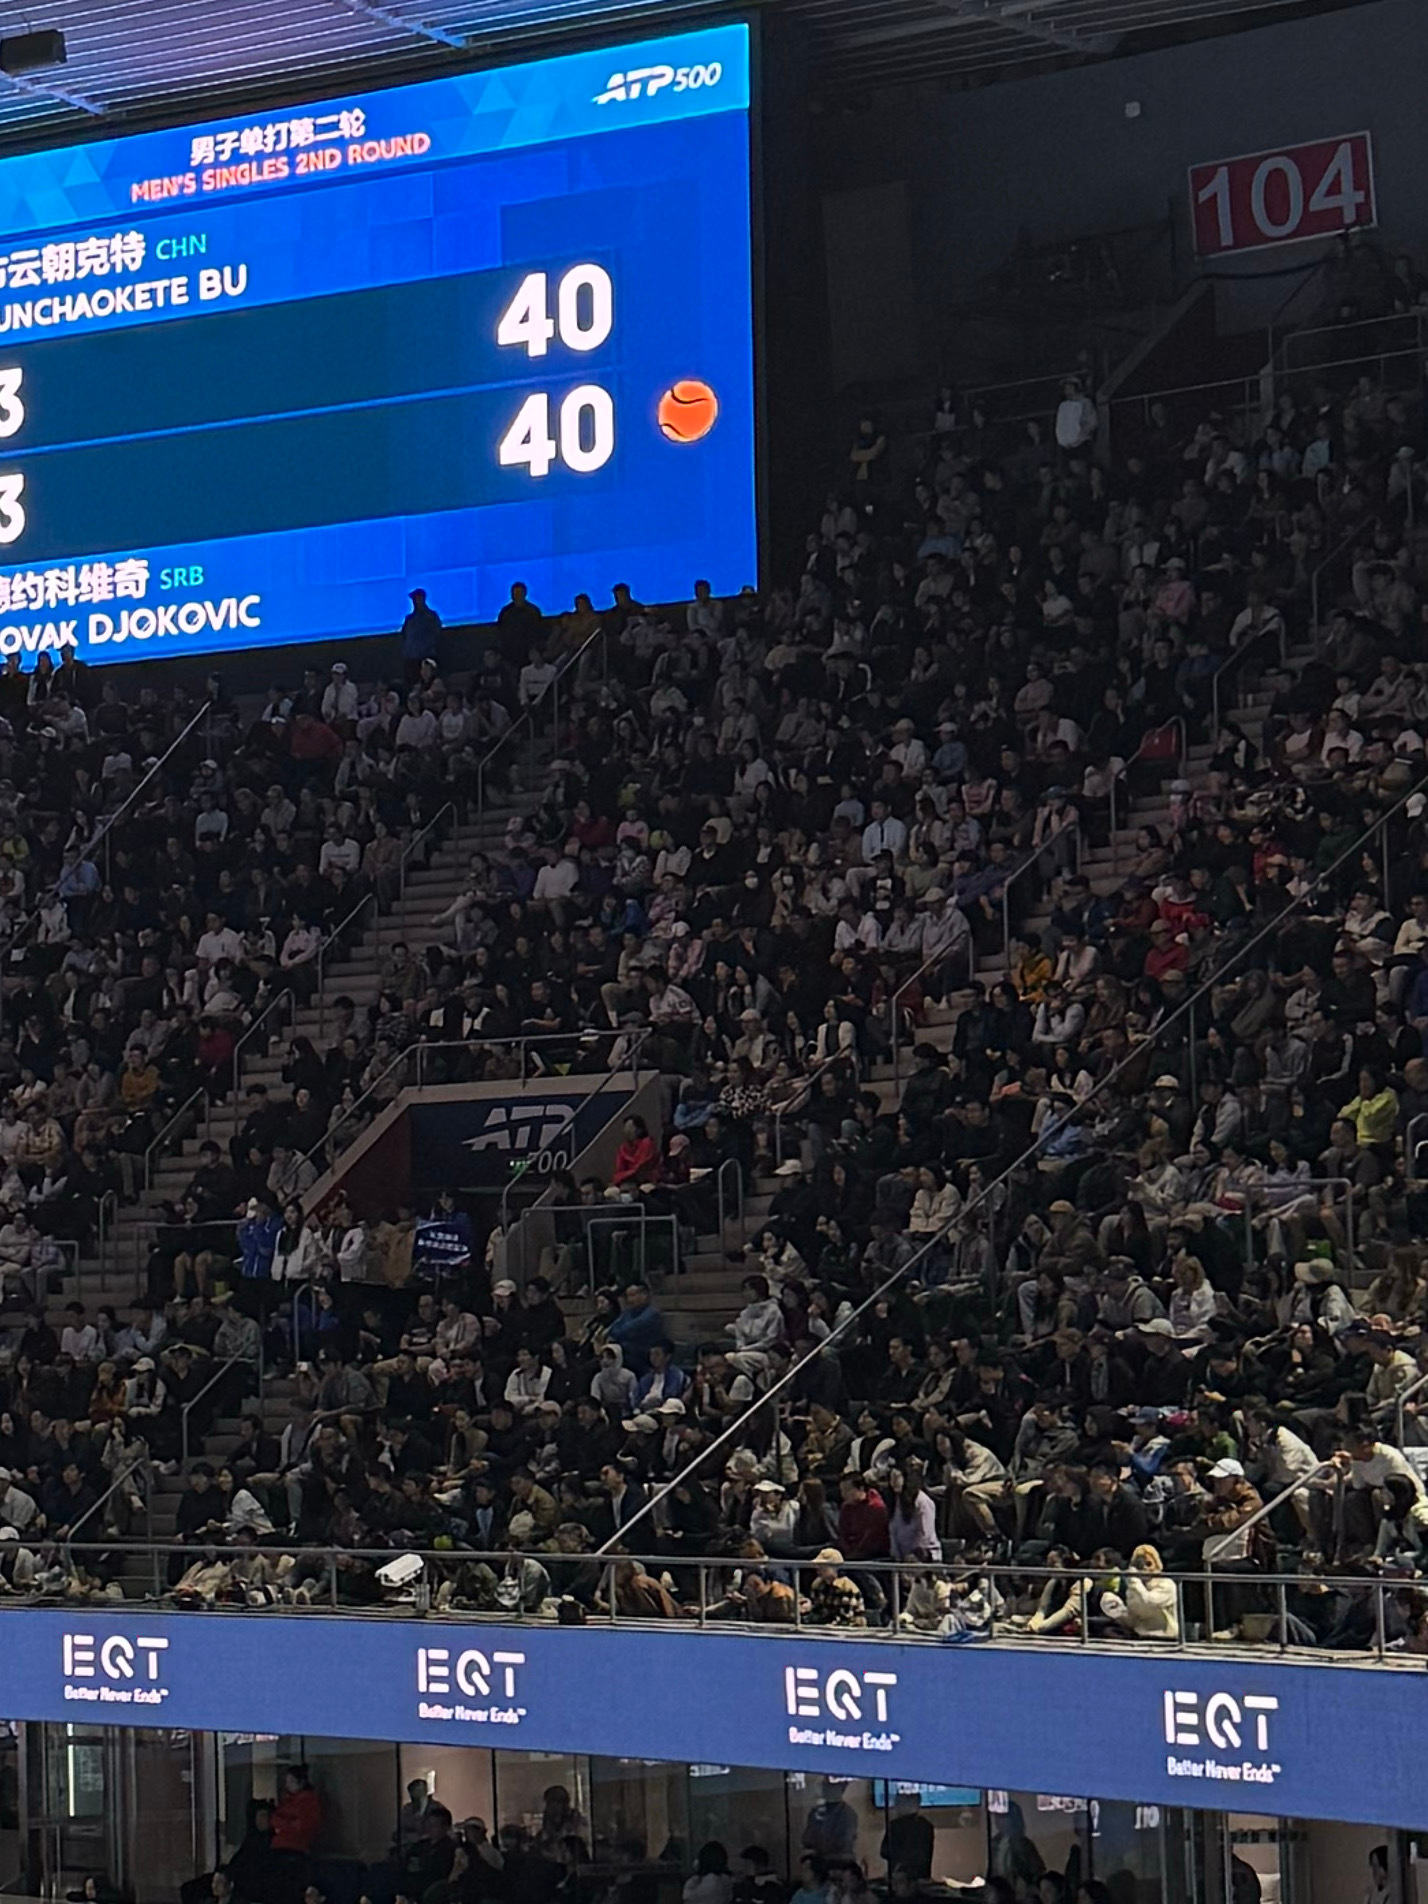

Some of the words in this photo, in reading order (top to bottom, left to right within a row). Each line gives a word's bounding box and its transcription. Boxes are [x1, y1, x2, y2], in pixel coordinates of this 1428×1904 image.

[190, 108, 366, 167] 男子单打第二轮
[130, 172, 198, 204] MEN'S
[202, 157, 290, 192] SINGLES
[295, 150, 342, 176] 2ND
[347, 132, 432, 166] ROUND
[1197, 141, 1366, 248] 104
[155, 233, 208, 260] CHN
[199, 264, 248, 300] BU
[497, 263, 613, 358] 40
[498, 384, 614, 477] 40
[158, 565, 204, 590] SRB
[87, 593, 262, 645] DJOKOVIC
[63, 1634, 169, 1680] EQT
[417, 1647, 526, 1698] EQT
[785, 1666, 897, 1722] EQT
[1164, 1690, 1279, 1751] EQT
